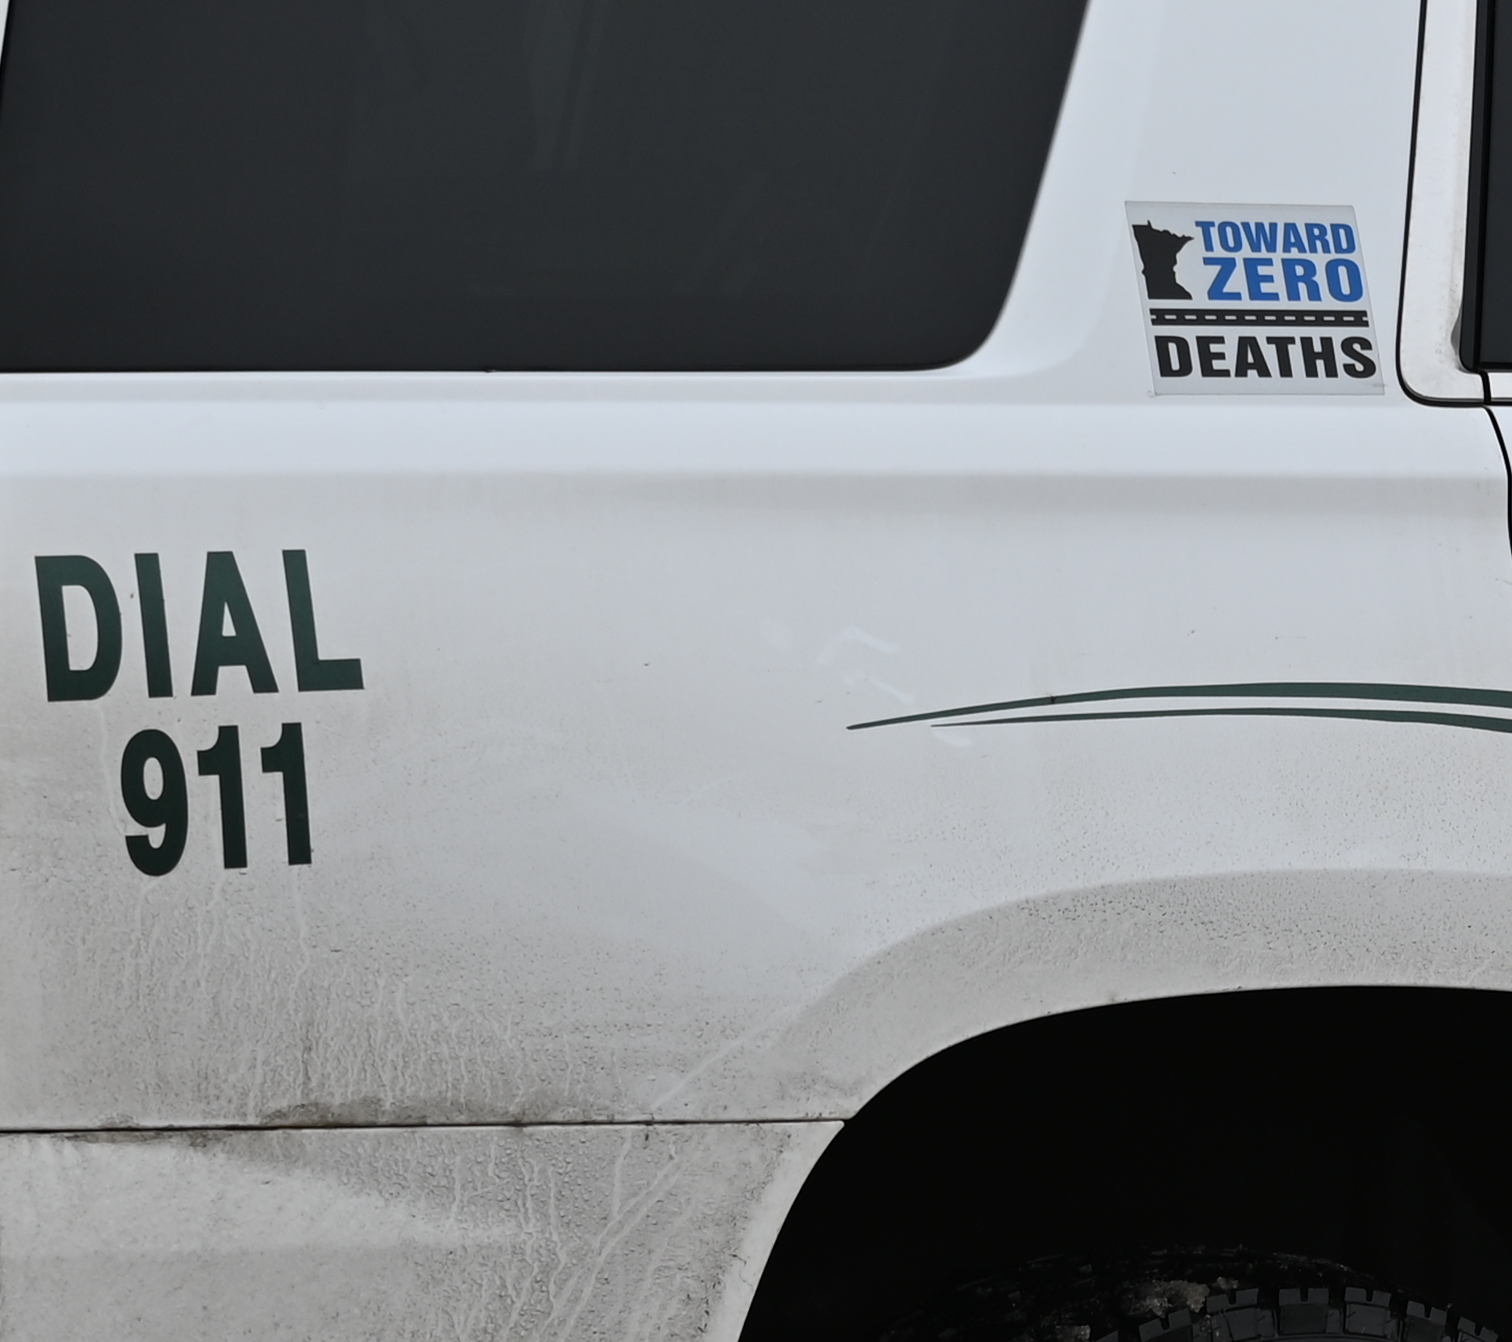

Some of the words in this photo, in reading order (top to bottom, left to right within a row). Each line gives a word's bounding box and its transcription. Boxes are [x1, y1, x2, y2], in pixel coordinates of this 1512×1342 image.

[1194, 220, 1356, 255] TOWARD
[1202, 256, 1364, 302] ZERO
[1154, 335, 1377, 379] DEATHS
[34, 549, 365, 702] DIAL
[120, 722, 312, 877] 911
